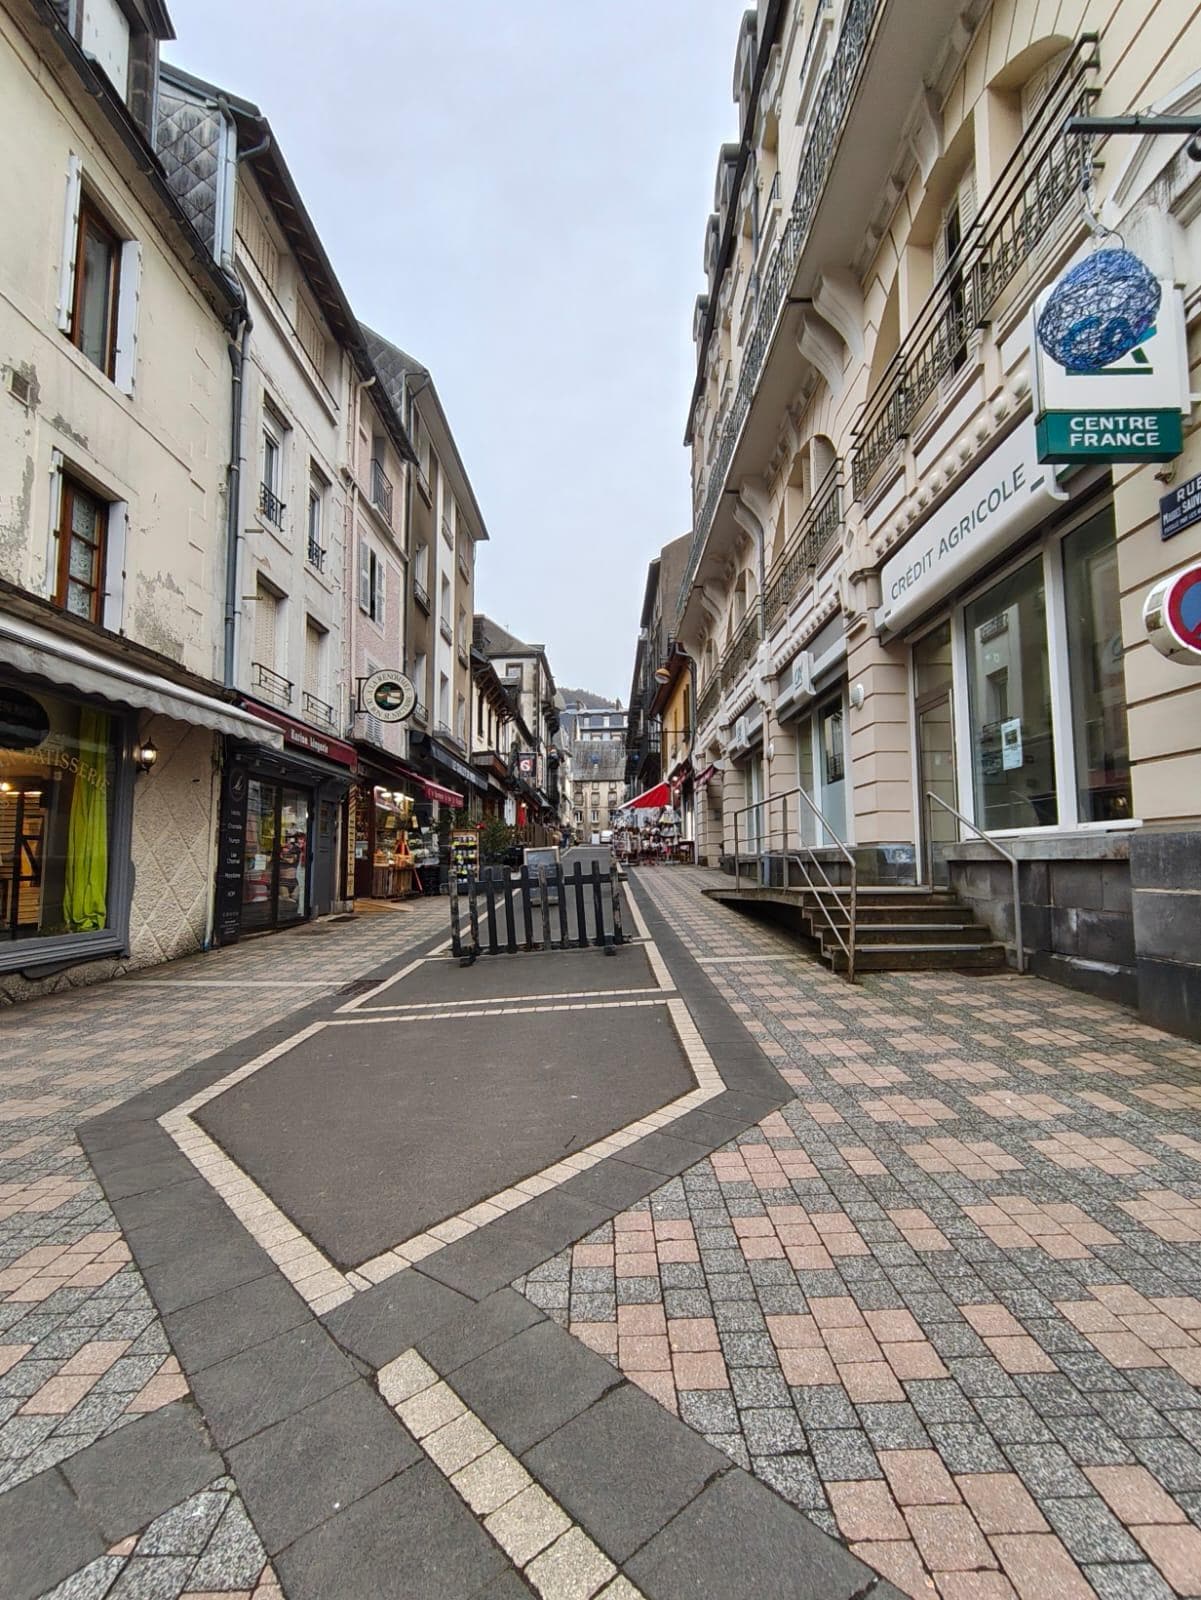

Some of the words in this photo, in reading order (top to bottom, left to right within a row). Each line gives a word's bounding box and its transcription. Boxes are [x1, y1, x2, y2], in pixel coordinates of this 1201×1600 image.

[1070, 416, 1159, 431] CENTRE
[1070, 432, 1160, 447] FRANCE
[1177, 476, 1201, 503] RUE
[891, 549, 934, 600] CRÉDIT
[938, 463, 1027, 560] AGRICOLE
